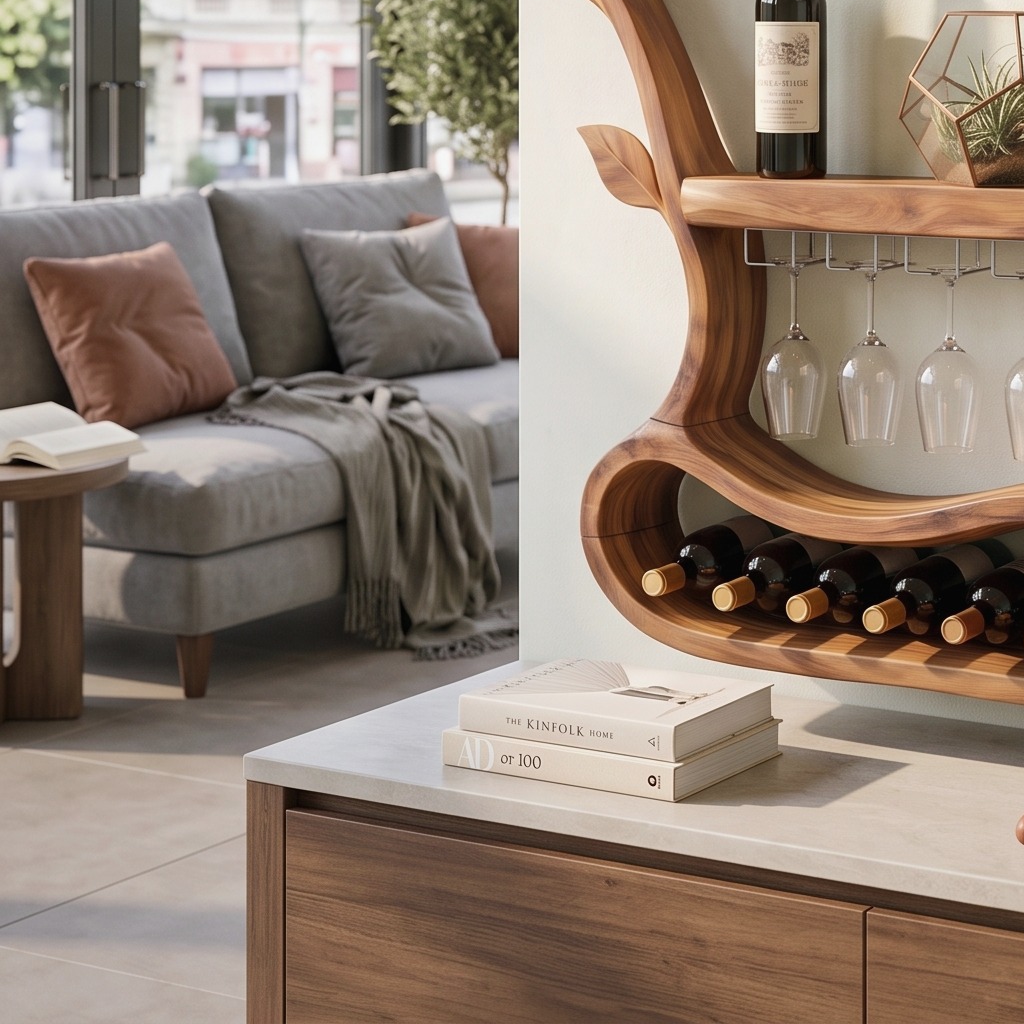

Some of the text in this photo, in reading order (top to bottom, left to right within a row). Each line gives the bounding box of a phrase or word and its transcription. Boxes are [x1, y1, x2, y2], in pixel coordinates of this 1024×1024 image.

[505, 716, 614, 739] THE KINFOLK HOME
[457, 736, 542, 771] AD or 100
